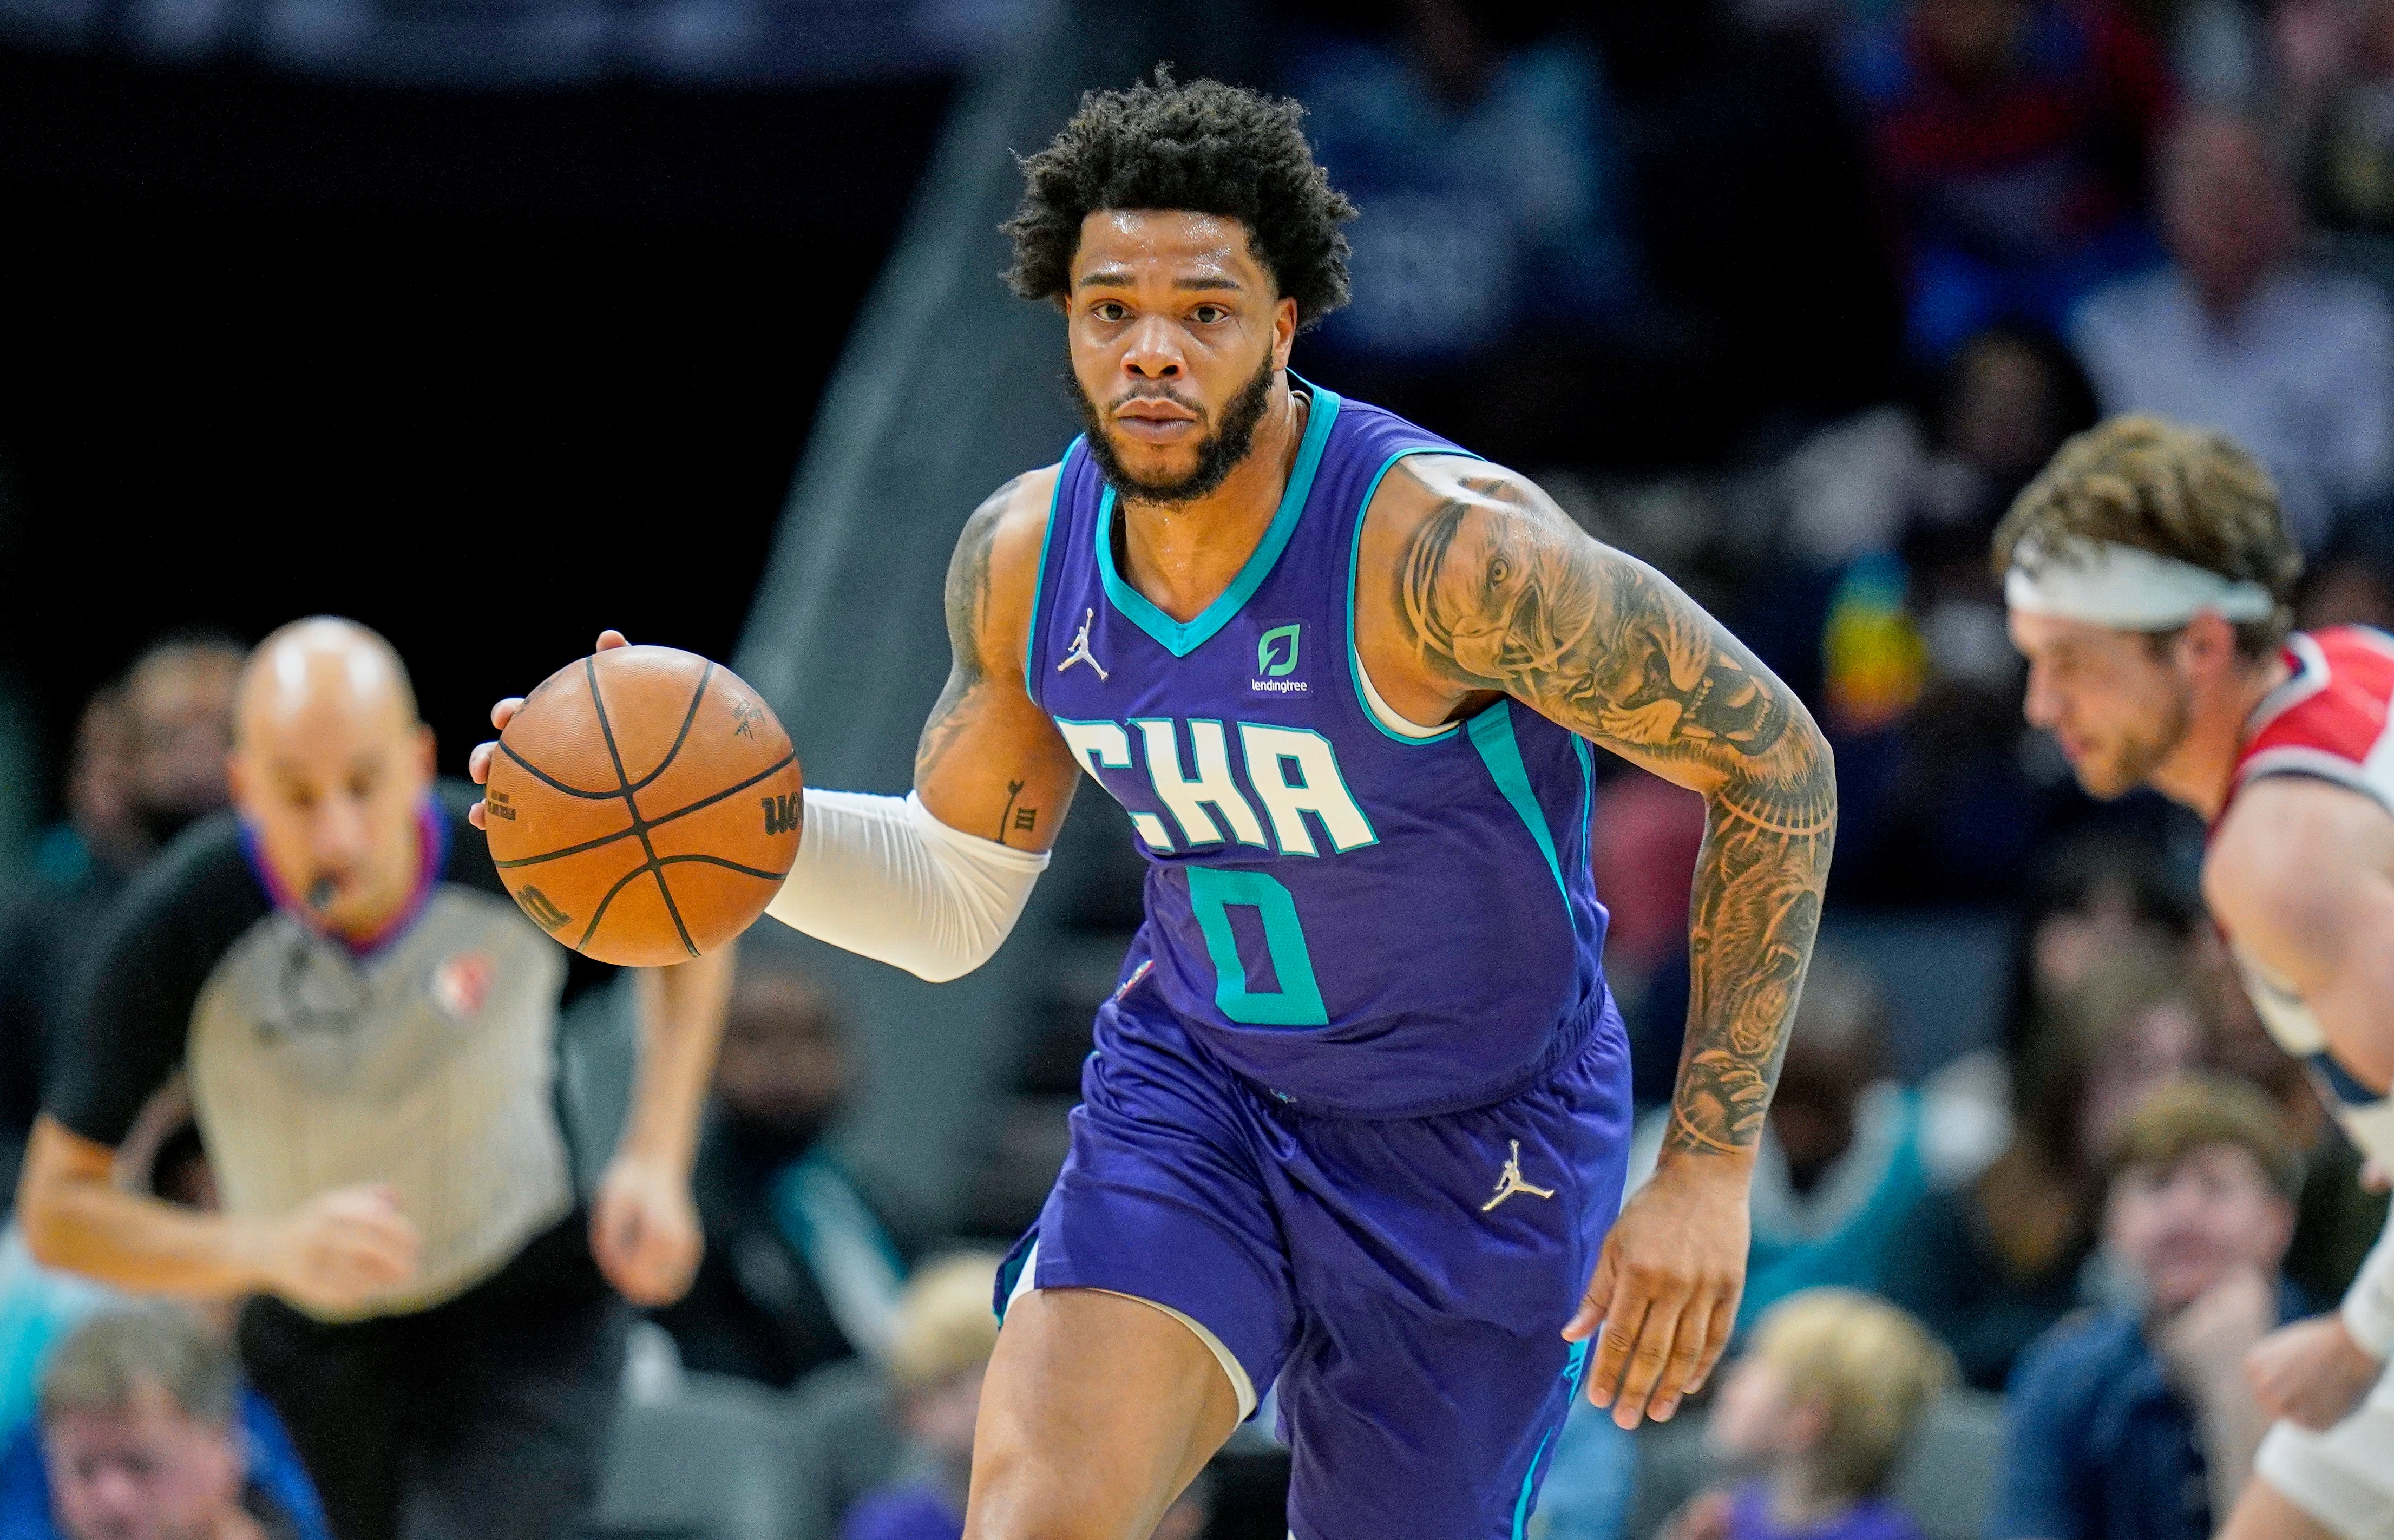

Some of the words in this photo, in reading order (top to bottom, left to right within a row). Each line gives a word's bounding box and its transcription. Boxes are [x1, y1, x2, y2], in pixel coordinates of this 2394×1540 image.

[1251, 679, 1308, 693] lendingtree
[1053, 715, 1379, 857] CHA
[1186, 866, 1329, 1025] 0
